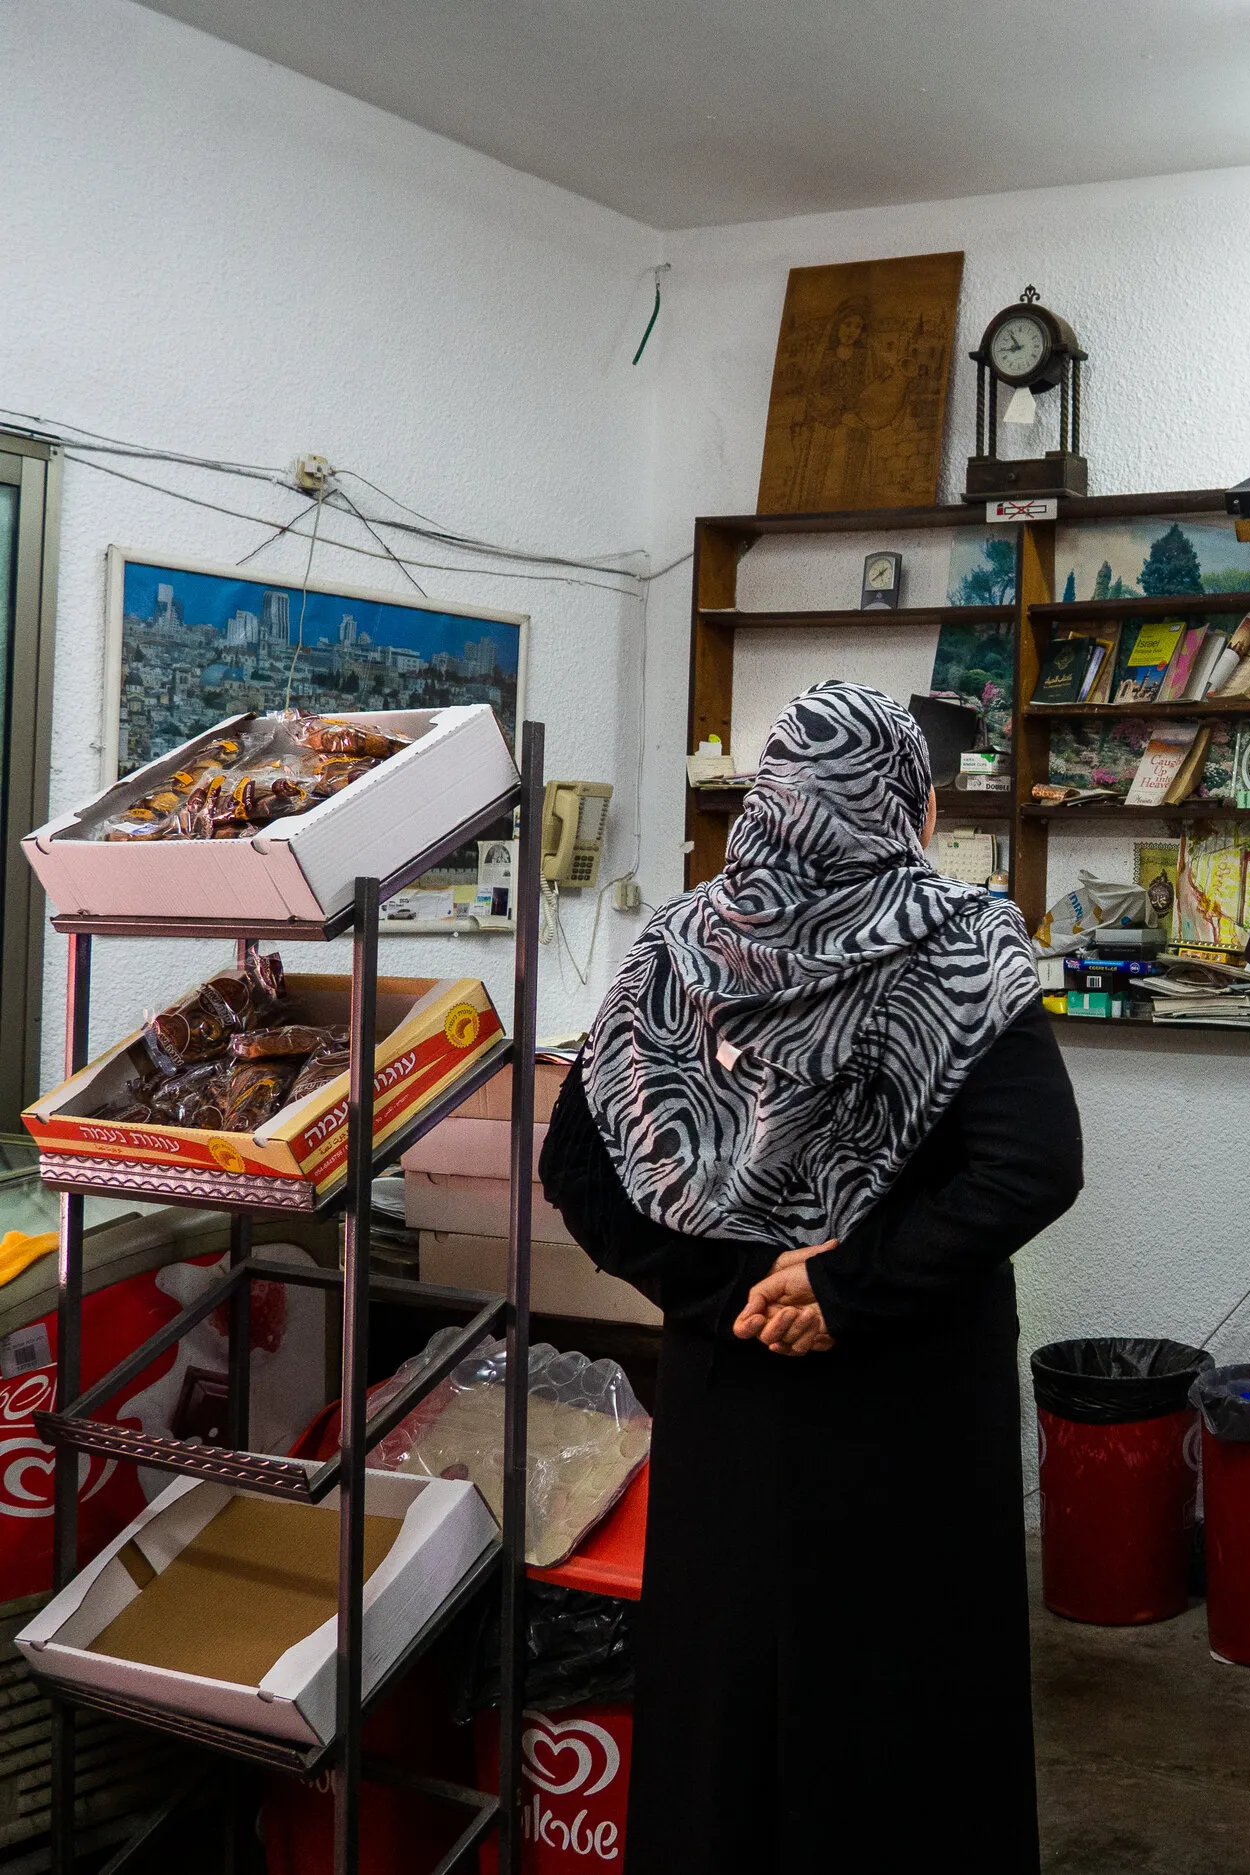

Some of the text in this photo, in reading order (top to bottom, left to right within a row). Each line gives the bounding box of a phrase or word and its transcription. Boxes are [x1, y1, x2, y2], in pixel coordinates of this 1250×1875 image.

[304, 1051, 416, 1148] עוגו עמה
[79, 1126, 127, 1144] נעמה
[130, 1132, 180, 1152] עוגות
